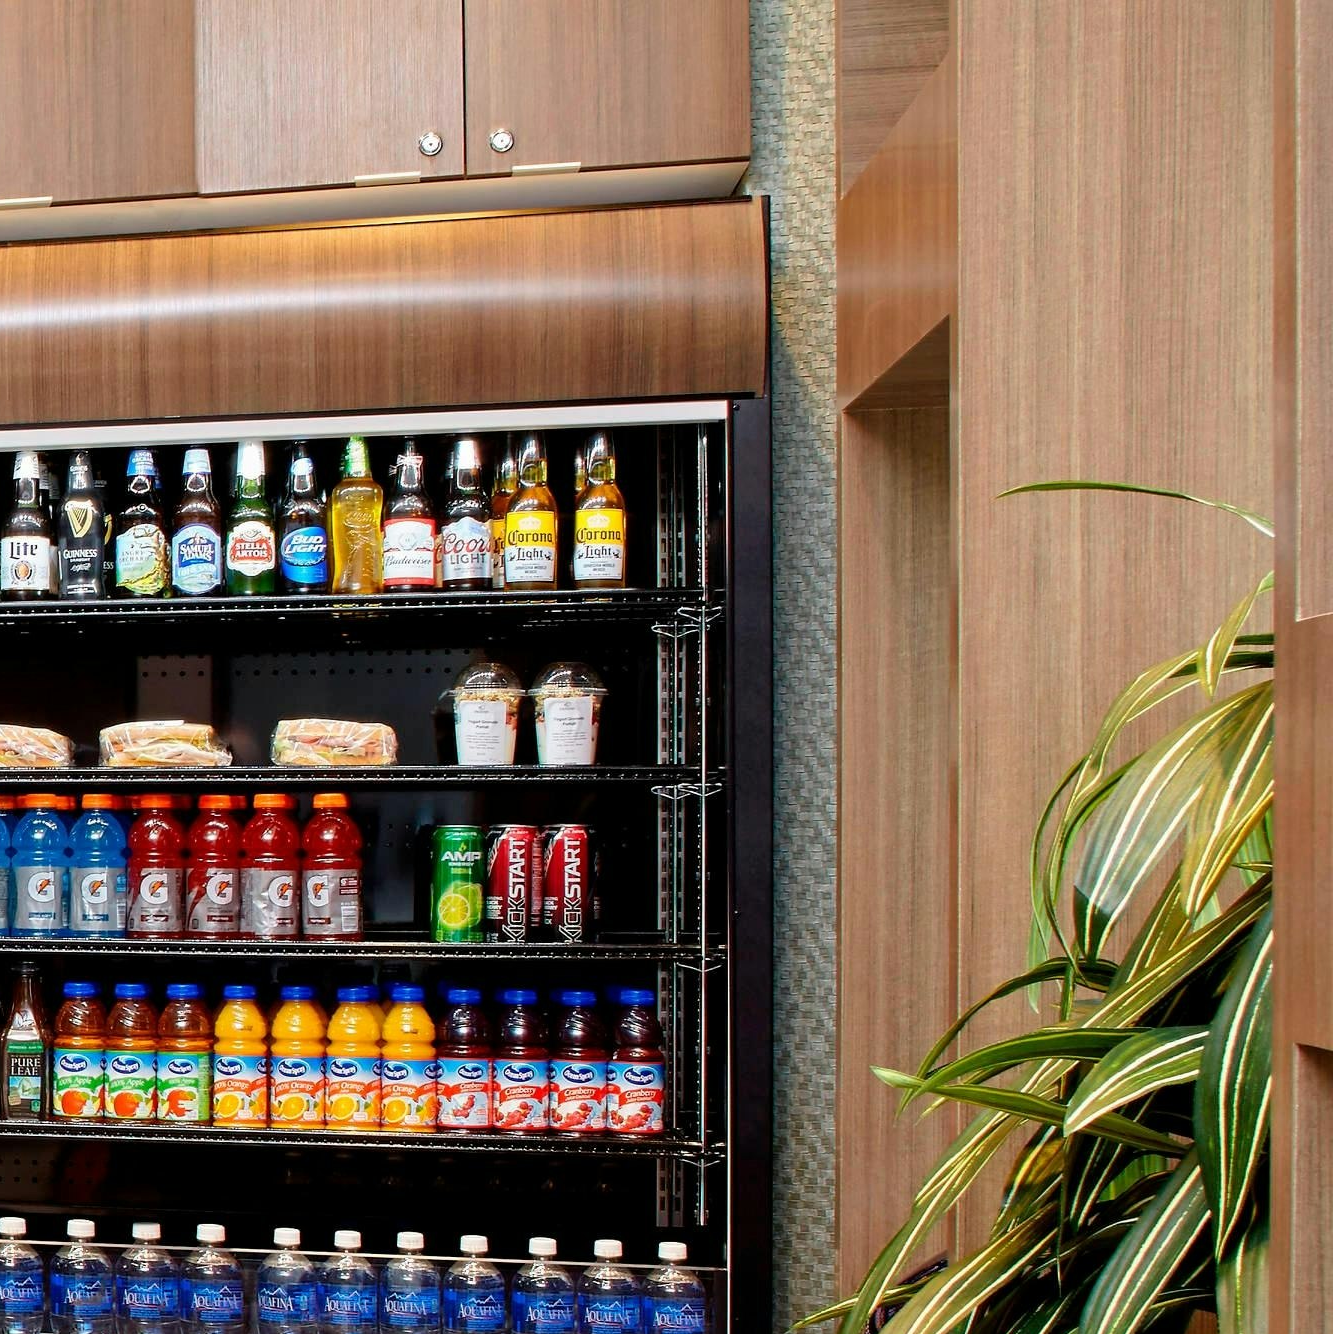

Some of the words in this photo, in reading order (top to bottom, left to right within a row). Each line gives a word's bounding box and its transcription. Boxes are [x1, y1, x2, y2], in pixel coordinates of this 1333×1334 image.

[508, 530, 553, 544] Corona
[575, 529, 621, 544] Corona
[180, 543, 214, 555] SAMUEL
[235, 542, 268, 552] STELLA
[442, 533, 491, 554] Coors
[10, 542, 38, 559] Lite
[63, 549, 98, 559] GUINNESS
[182, 551, 213, 562] ADAMS
[236, 549, 269, 559] ARTOIS
[516, 548, 544, 562] Light
[585, 547, 612, 559] Light
[385, 555, 432, 567] Budweiser
[449, 554, 487, 564] LIGHT
[441, 851, 482, 862] AMP
[28, 871, 54, 901] G
[82, 873, 108, 903] G
[140, 873, 168, 903] G
[206, 873, 233, 904] G
[268, 876, 293, 906] G
[307, 875, 329, 905] G
[501, 836, 526, 944] KICKSTART
[558, 836, 583, 944] KICKSTART
[11, 1058, 40, 1067] PURE
[11, 1066, 38, 1076] LEAF
[290, 1082, 314, 1093] Orange
[391, 1084, 416, 1095] Orange
[501, 1087, 537, 1098] Cranberry
[564, 1087, 598, 1098] Cranberry
[625, 1089, 656, 1099] Cranberry
